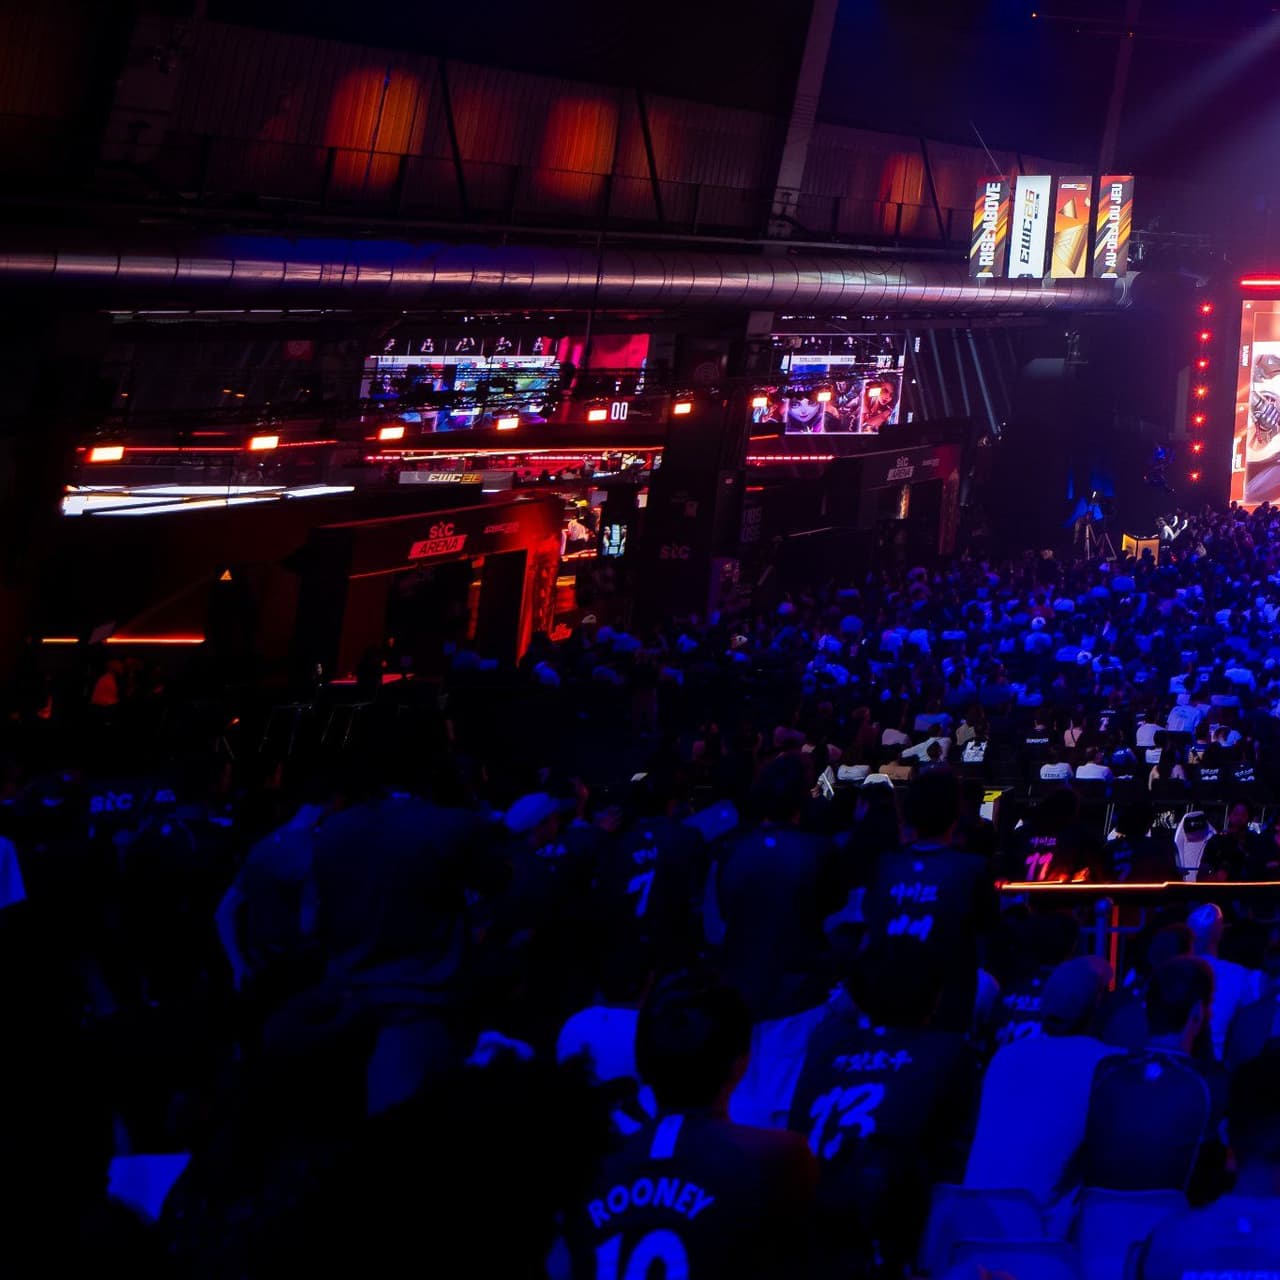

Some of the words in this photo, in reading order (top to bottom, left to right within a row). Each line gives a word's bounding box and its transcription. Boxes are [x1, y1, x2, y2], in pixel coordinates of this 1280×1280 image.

[984, 183, 1001, 231] ABOVE
[979, 233, 996, 266] RISE
[429, 521, 455, 538] stc
[416, 540, 459, 555] ARENA
[587, 1177, 716, 1228] ROONEY
